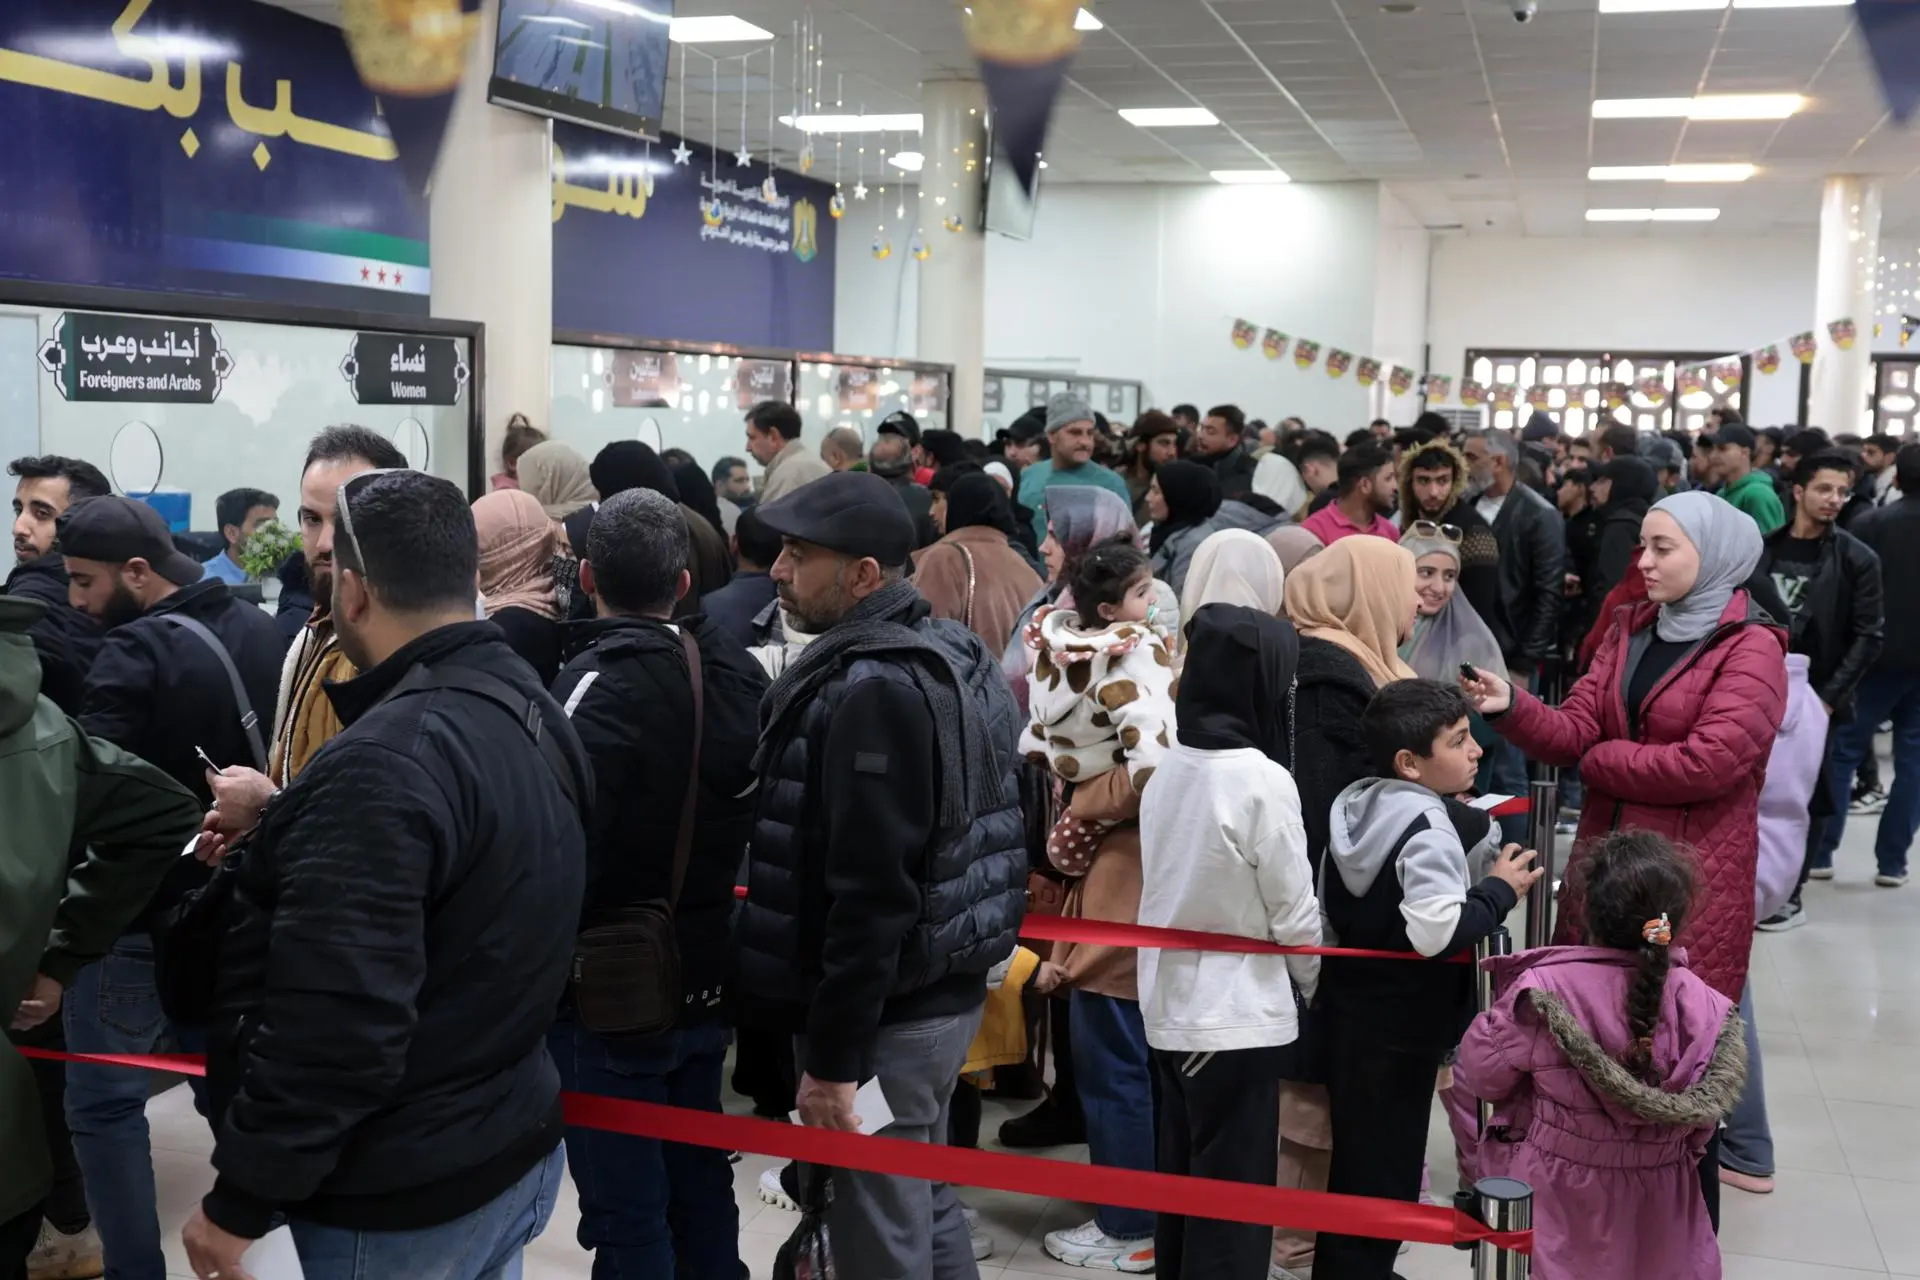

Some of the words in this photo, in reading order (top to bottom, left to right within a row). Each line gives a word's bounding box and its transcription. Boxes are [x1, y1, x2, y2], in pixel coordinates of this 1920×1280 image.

[81, 334, 137, 364] وعرب
[140, 326, 200, 366] أجانب
[391, 342, 426, 373] نساء
[80, 369, 145, 392] Foreigners
[146, 373, 168, 390] and
[168, 373, 202, 391] Arabs
[391, 380, 427, 399] Women
